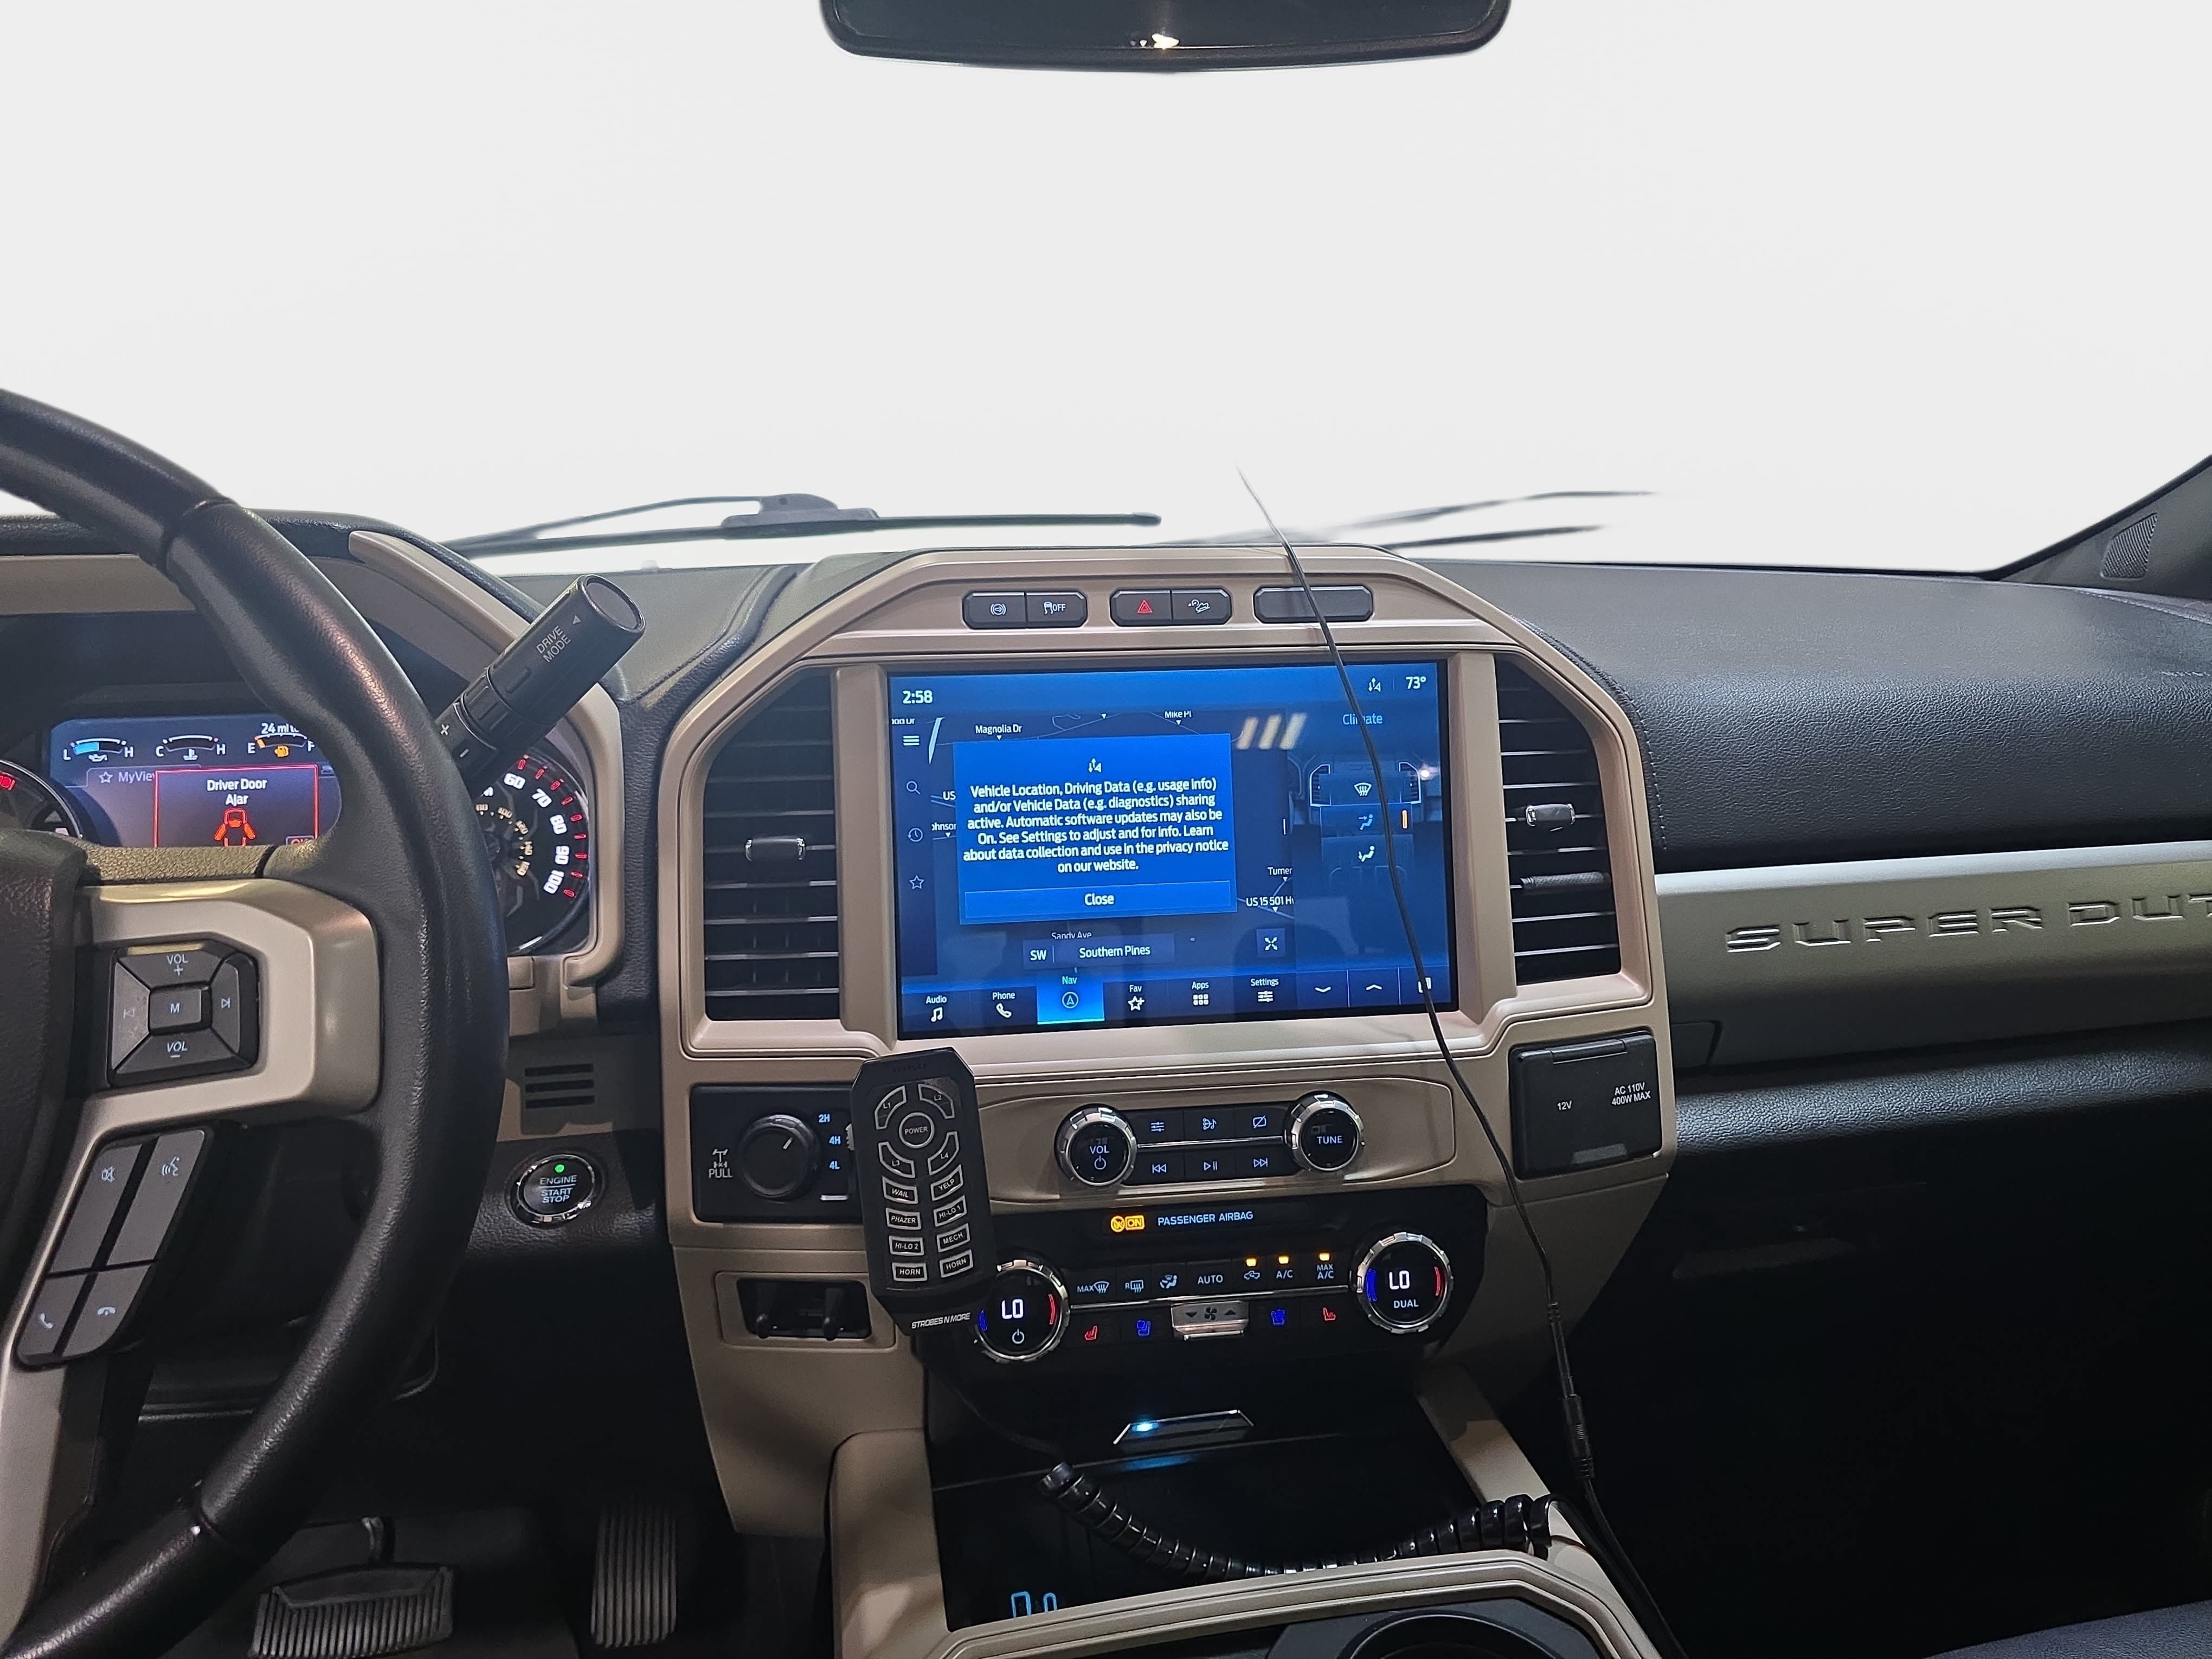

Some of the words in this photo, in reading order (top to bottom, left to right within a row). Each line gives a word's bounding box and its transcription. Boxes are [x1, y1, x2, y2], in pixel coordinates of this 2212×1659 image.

[1052, 603, 1066, 612] OFF
[536, 625, 563, 654] DRIVE
[543, 634, 571, 663] MODE
[1406, 676, 1426, 689] 73°
[902, 690, 933, 704] 2:58
[261, 723, 276, 734] 24
[975, 724, 1012, 735] Magnolia
[1013, 724, 1022, 732] Dr
[156, 746, 164, 757] C
[217, 744, 226, 755] H
[248, 742, 255, 754] E
[307, 740, 315, 752] F
[63, 749, 71, 760] L
[124, 746, 134, 758] H
[119, 771, 155, 783] MyVie
[504, 773, 526, 789] 60
[207, 779, 239, 791] Driver
[241, 778, 267, 790] Door
[970, 785, 1011, 798] Vehicle
[1012, 783, 1063, 796] Location,
[1064, 782, 1102, 795] Driving
[1104, 781, 1130, 793] Data
[1133, 780, 1156, 794] (e.g.
[1158, 781, 1189, 792] usage
[1191, 777, 1217, 791] info)
[226, 793, 249, 807] Ajar
[532, 788, 552, 808] 70
[943, 791, 956, 800] US
[973, 801, 1012, 813] and/or
[1013, 799, 1053, 812] Vehicle
[1054, 798, 1081, 811] Data
[1083, 797, 1107, 811] (e.g.
[1108, 794, 1174, 809] diagnostics)
[1176, 794, 1216, 807] sharing
[550, 814, 567, 834] 80
[967, 817, 1004, 829] active.
[1006, 814, 1063, 828] Automatic
[1065, 813, 1113, 825] software
[1115, 811, 1159, 825] updates
[1160, 812, 1183, 823] may
[1185, 809, 1207, 821] also
[1208, 808, 1223, 820] be
[516, 820, 529, 834] 120
[978, 832, 997, 845] On.
[999, 832, 1020, 844] See
[1021, 829, 1067, 844] Settings
[1069, 830, 1081, 841] to
[1083, 828, 1116, 841] adjust
[1118, 826, 1139, 839] and
[1141, 826, 1156, 838] for
[1158, 825, 1182, 838] info.
[1184, 825, 1214, 837] Learn
[555, 845, 570, 865] 90
[963, 848, 996, 861] about
[998, 847, 1025, 859] data
[1026, 845, 1079, 859] collection
[1081, 844, 1102, 857] and
[1103, 845, 1122, 856] use
[1123, 843, 1134, 854] in
[1135, 841, 1154, 854] the
[1156, 841, 1193, 856] privacy
[1195, 839, 1229, 852] notice
[1057, 862, 1072, 873] on
[1074, 861, 1091, 872] our
[1093, 858, 1139, 871] website.
[1267, 866, 1293, 876] Turner
[543, 870, 564, 894] 100
[1084, 892, 1115, 905] Close
[1246, 897, 1258, 907] US
[1259, 897, 1268, 906] 15
[1269, 896, 1284, 906] 501
[1726, 906, 2043, 954] SUPER
[1030, 949, 1047, 961] SW
[1079, 946, 1123, 959] Southern
[1124, 945, 1150, 956] Pines
[166, 954, 188, 965] VOL
[1062, 976, 1078, 985] Nav
[1250, 978, 1279, 987] Settings
[1129, 984, 1142, 993] Fav
[1192, 982, 1209, 992] Apps
[926, 994, 947, 1004] Audio
[992, 991, 1015, 1001] Phone
[170, 1003, 180, 1013] M
[166, 1041, 188, 1052] VOL
[1615, 1085, 1626, 1096] AC
[1628, 1082, 1645, 1093] 110V
[1611, 1095, 1632, 1105] 400W
[1633, 1091, 1651, 1102] MAX
[1557, 1101, 1572, 1111] 12V
[818, 1113, 830, 1123] 2H
[904, 1126, 928, 1135] POWER
[829, 1135, 841, 1145] 4H
[1316, 1135, 1343, 1145] TUNE
[1089, 1145, 1110, 1155] VOL
[829, 1161, 840, 1170] 4L
[709, 1168, 733, 1178] PULL
[539, 1175, 577, 1185] ENGINE
[938, 1178, 955, 1191] YELP
[541, 1187, 573, 1197] START
[891, 1188, 909, 1198] WAIL
[542, 1195, 570, 1204] STOP
[938, 1207, 956, 1219] HI-LO
[1158, 1213, 1216, 1226] PASSENGER
[1218, 1211, 1253, 1221] AIRBAG
[891, 1215, 916, 1224] PHAZER
[1128, 1218, 1142, 1227] ON
[943, 1232, 963, 1244] MECH
[895, 1242, 913, 1250] HI-LO
[946, 1258, 967, 1270] HORN
[1197, 1275, 1223, 1285] AUTO
[1276, 1270, 1293, 1279] A/C
[1317, 1270, 1334, 1280] A/C
[1077, 1285, 1094, 1293] MAX
[1393, 1299, 1419, 1308] DUAL
[911, 1317, 943, 1329] STROBES
[950, 1313, 970, 1322] MORE
